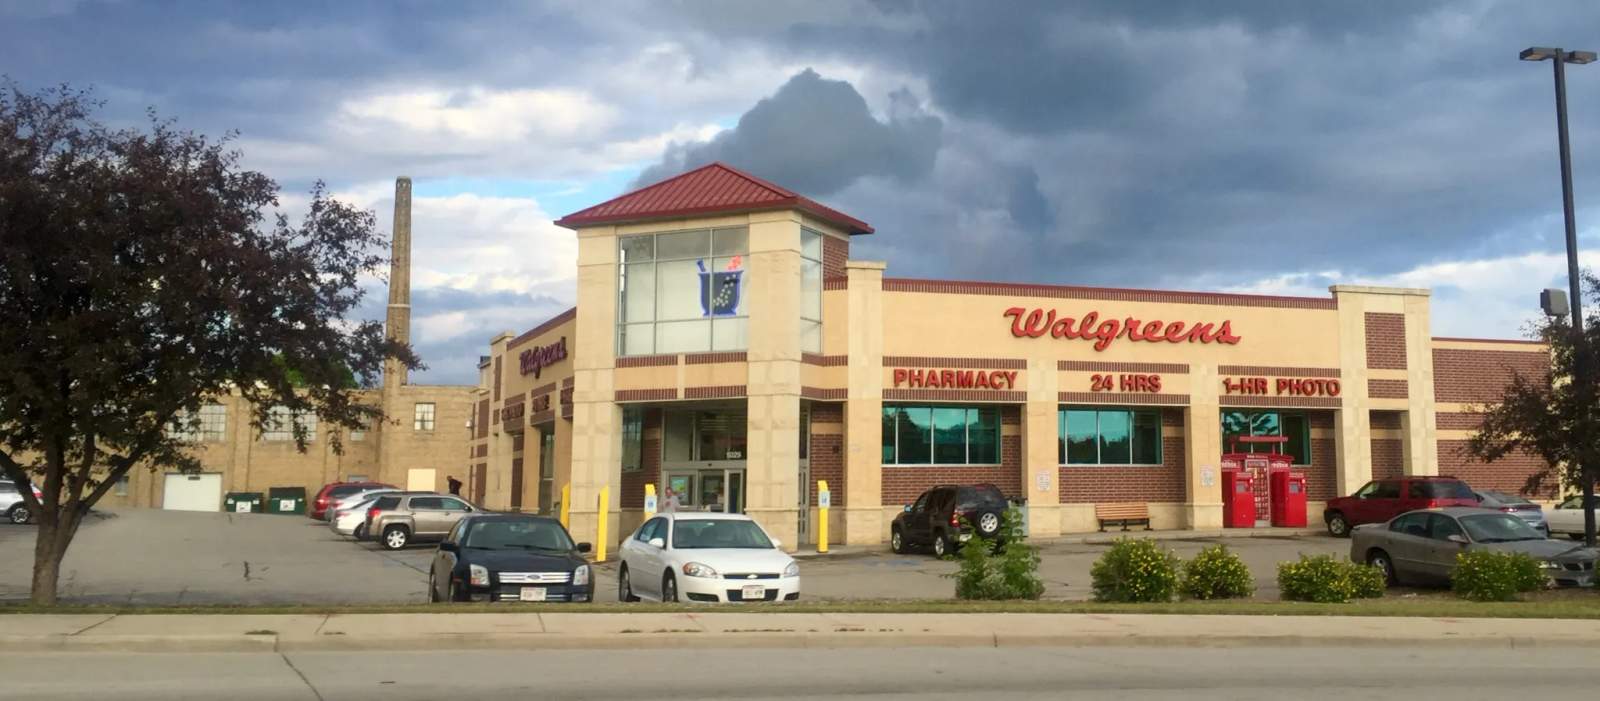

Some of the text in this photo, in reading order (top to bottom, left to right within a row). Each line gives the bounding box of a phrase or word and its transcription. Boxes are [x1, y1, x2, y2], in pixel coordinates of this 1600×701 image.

[1003, 307, 1242, 352] Walgreens
[893, 368, 1018, 389] PHARMACY
[1090, 374, 1162, 393] 24 HRS
[1222, 377, 1341, 396] 1-HR PHOTO
